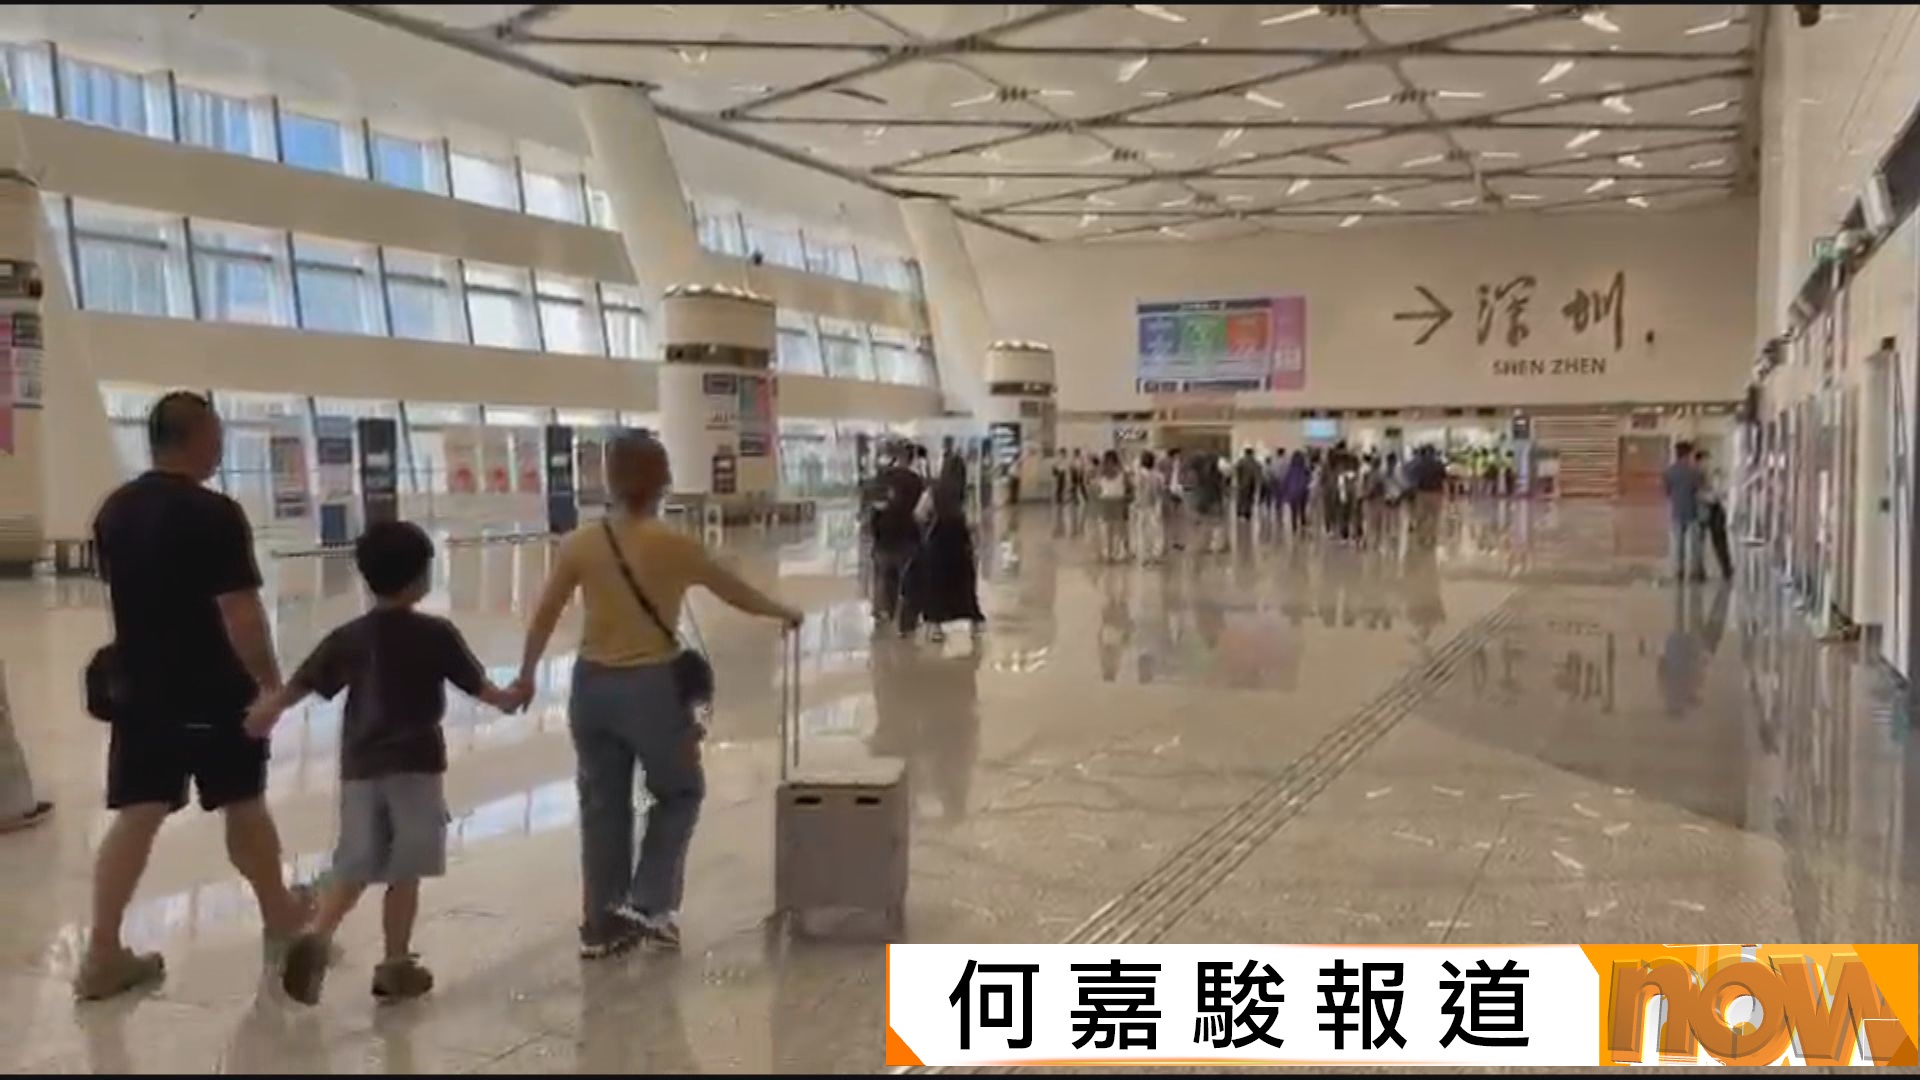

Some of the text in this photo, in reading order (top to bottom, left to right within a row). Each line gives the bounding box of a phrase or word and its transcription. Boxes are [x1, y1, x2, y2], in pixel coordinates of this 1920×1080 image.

[1477, 270, 1625, 351] 深圳
[1492, 356, 1607, 376] SHEN ZHEN
